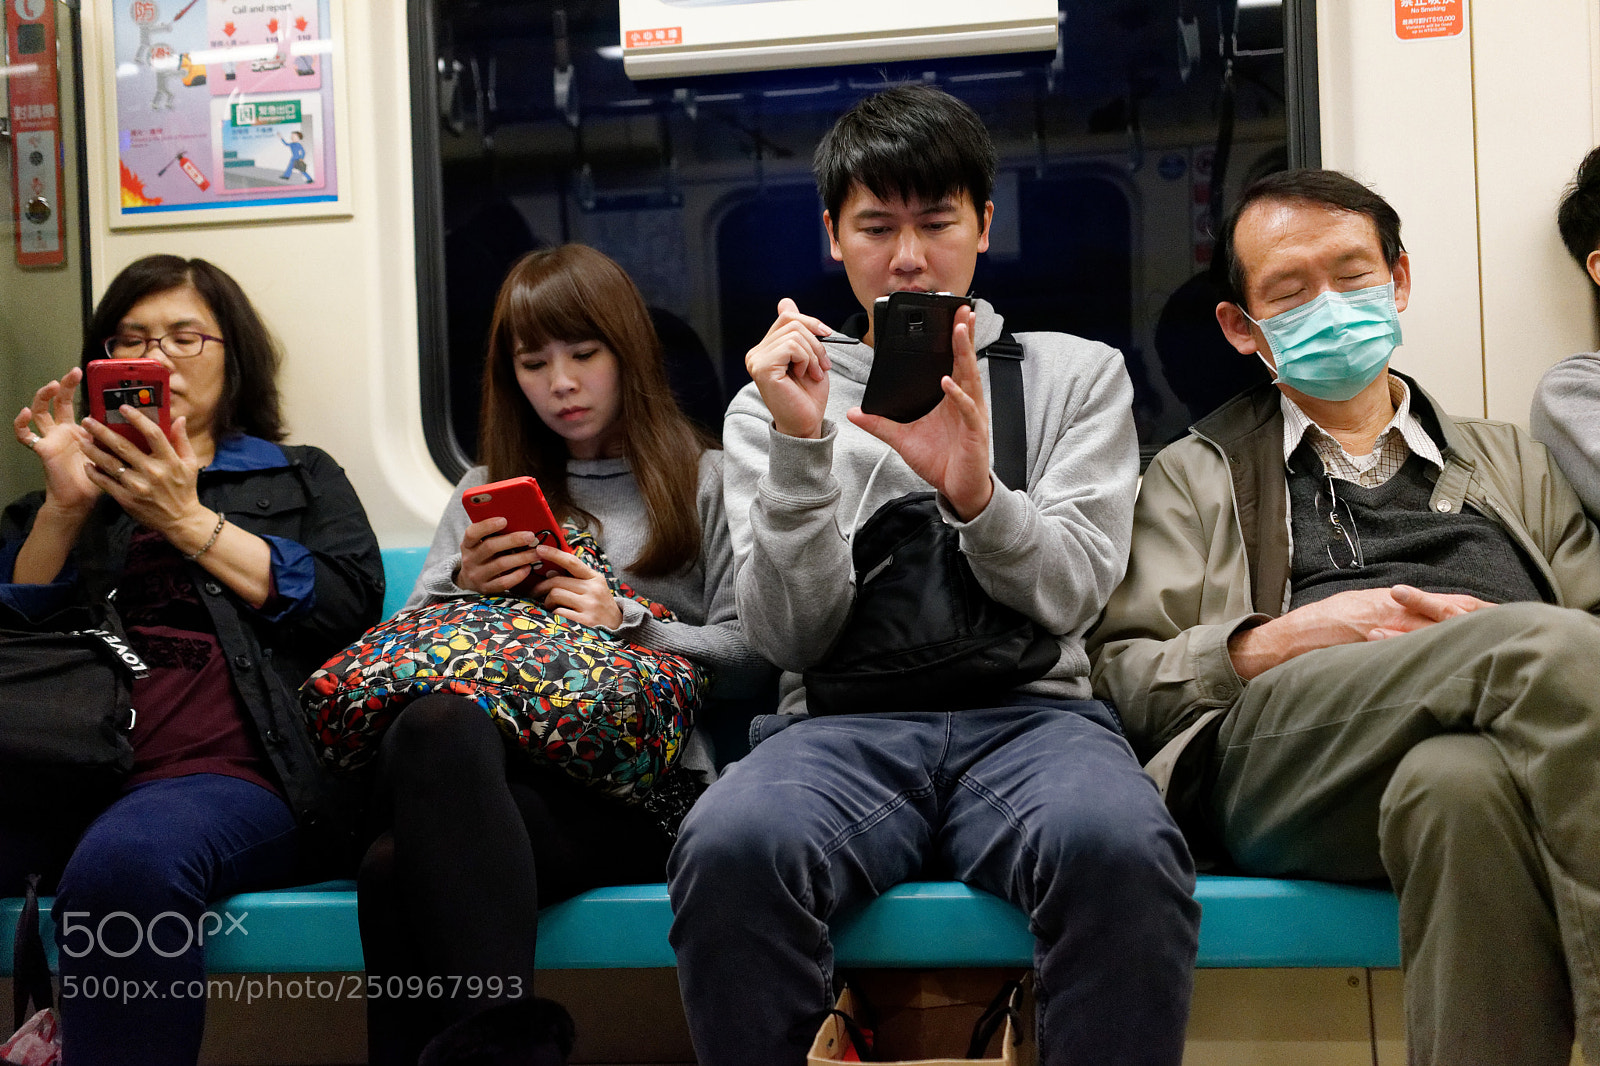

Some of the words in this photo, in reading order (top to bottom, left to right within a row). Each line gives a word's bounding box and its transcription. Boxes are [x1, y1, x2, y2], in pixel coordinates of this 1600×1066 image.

[232, 5, 247, 15] Call
[249, 4, 265, 13] and
[266, 3, 292, 12] report
